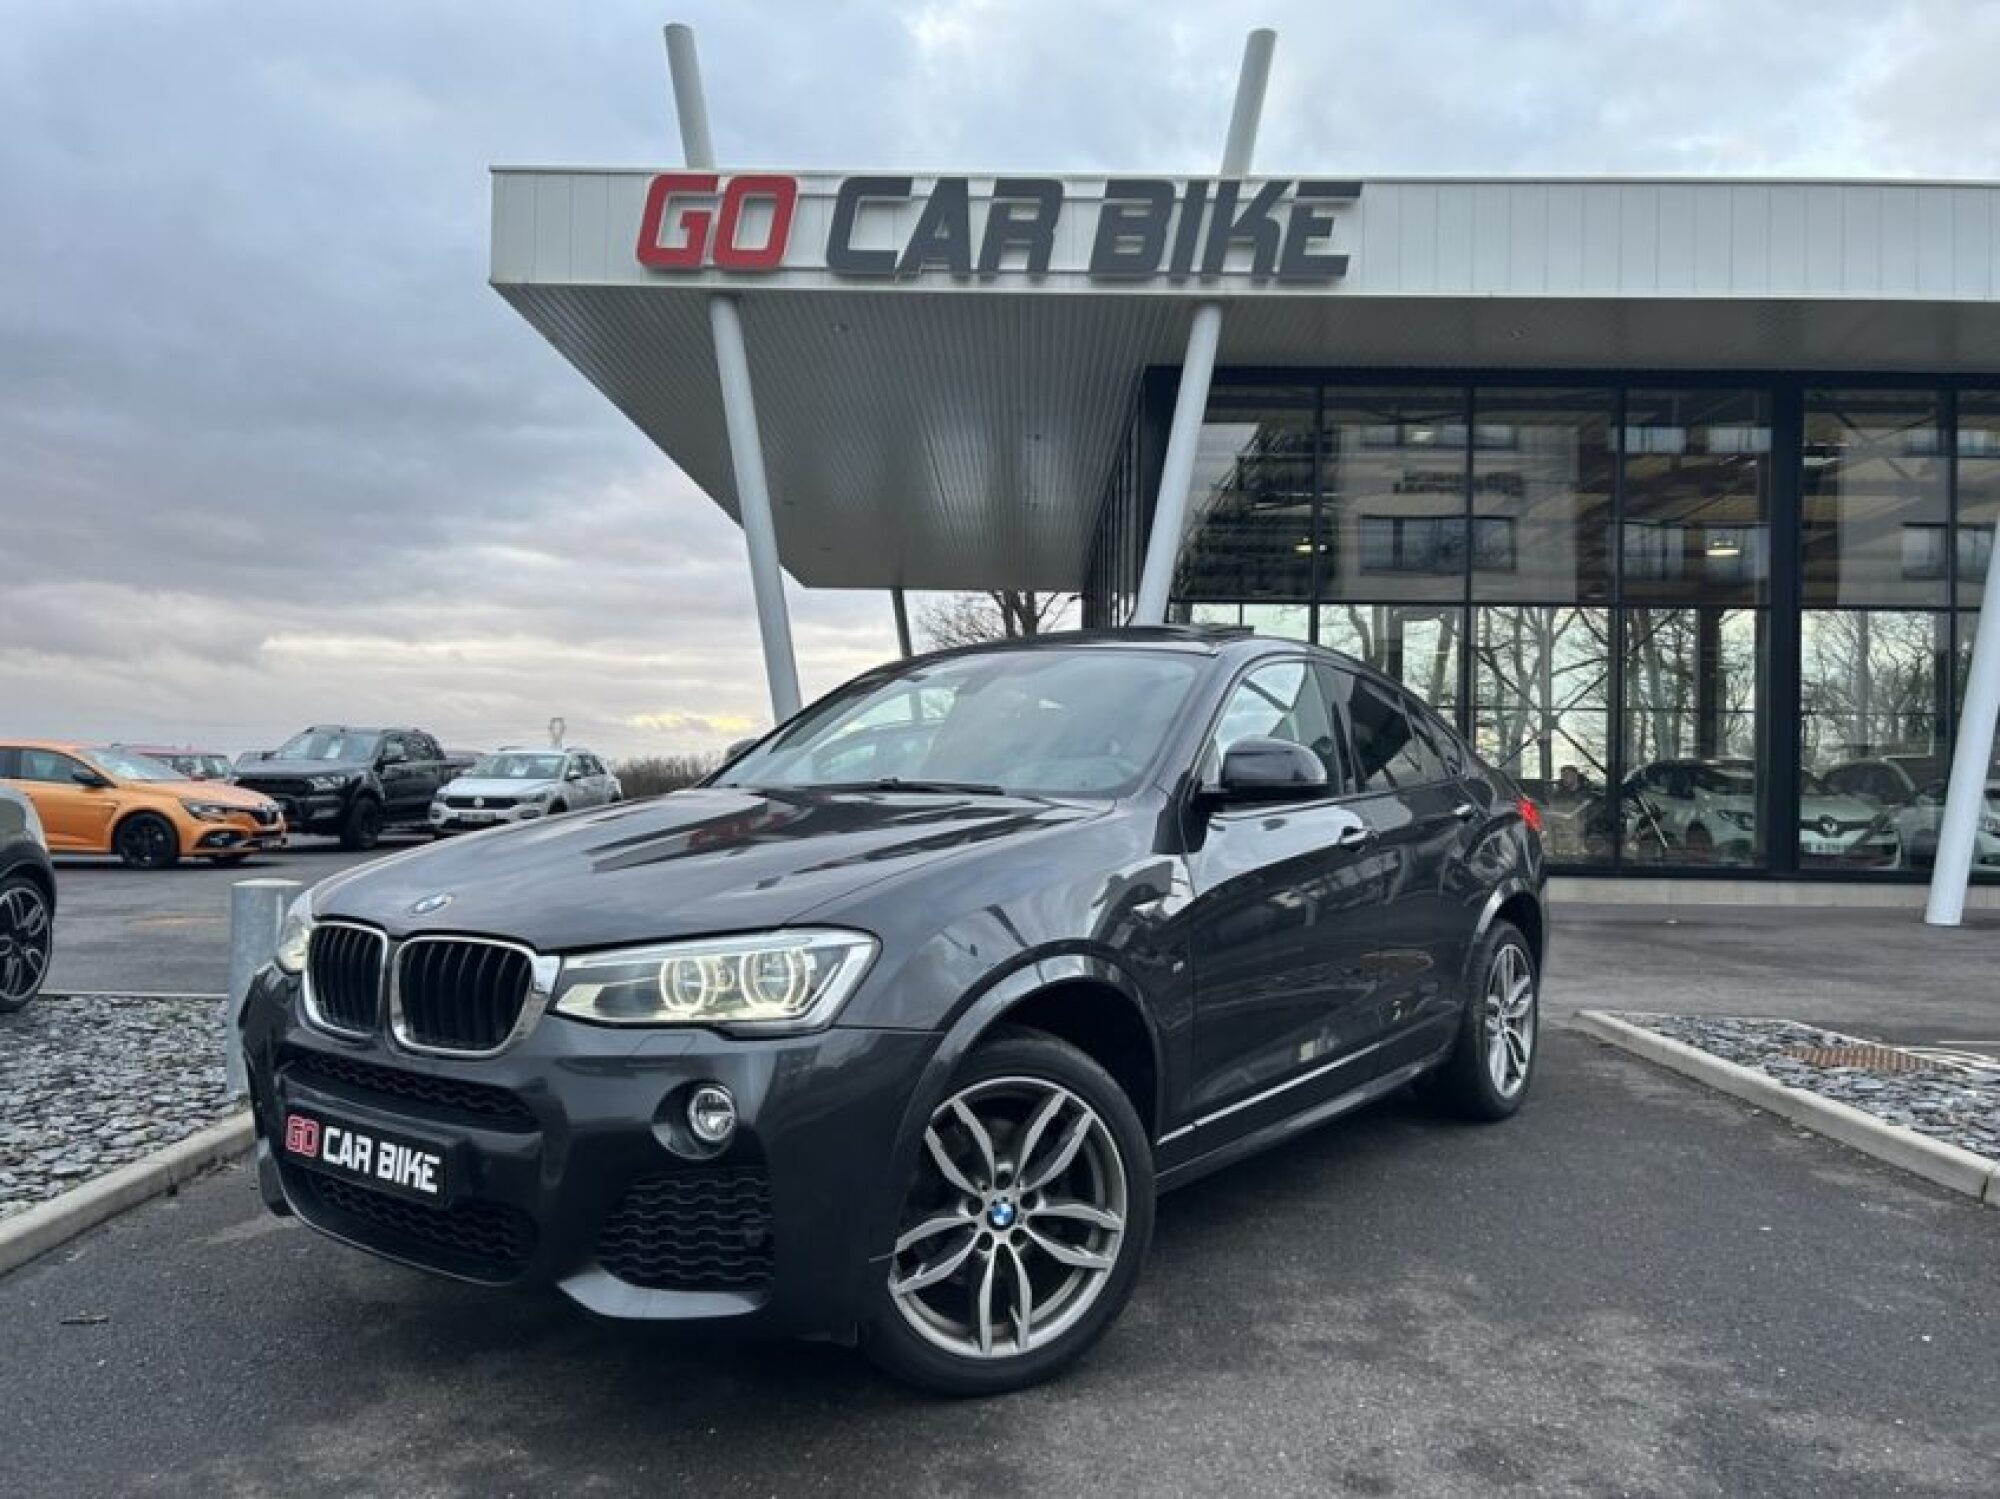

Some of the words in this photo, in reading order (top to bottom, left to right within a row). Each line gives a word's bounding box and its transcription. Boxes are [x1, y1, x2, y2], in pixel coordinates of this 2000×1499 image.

[636, 174, 798, 271] GO
[825, 177, 1065, 282] CAR
[1088, 179, 1363, 284] BIKE
[286, 1114, 319, 1157] GO
[322, 1126, 372, 1173] CAR
[377, 1142, 441, 1193] BIKE
